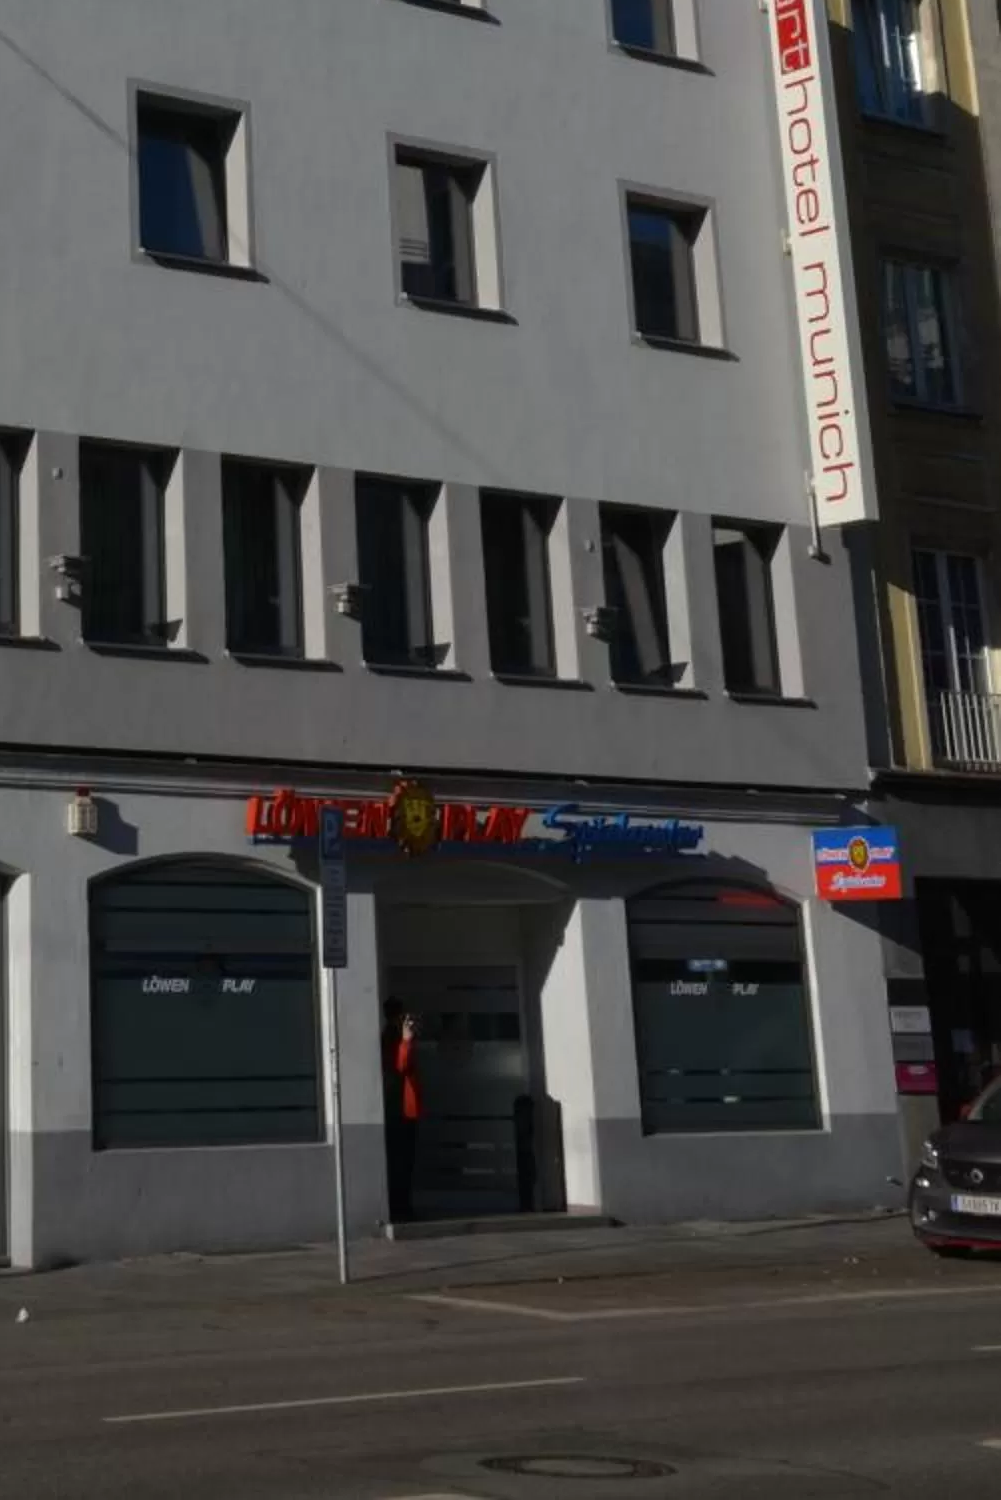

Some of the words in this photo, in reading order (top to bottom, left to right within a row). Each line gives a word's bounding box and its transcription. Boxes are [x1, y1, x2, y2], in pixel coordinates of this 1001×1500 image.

[802, 261, 855, 502] munich
[442, 802, 533, 843] PLAY
[142, 974, 190, 994] LÖWEN
[222, 978, 256, 994] PLAY
[670, 980, 709, 996] LÖWEN
[730, 982, 760, 996] PLAY
